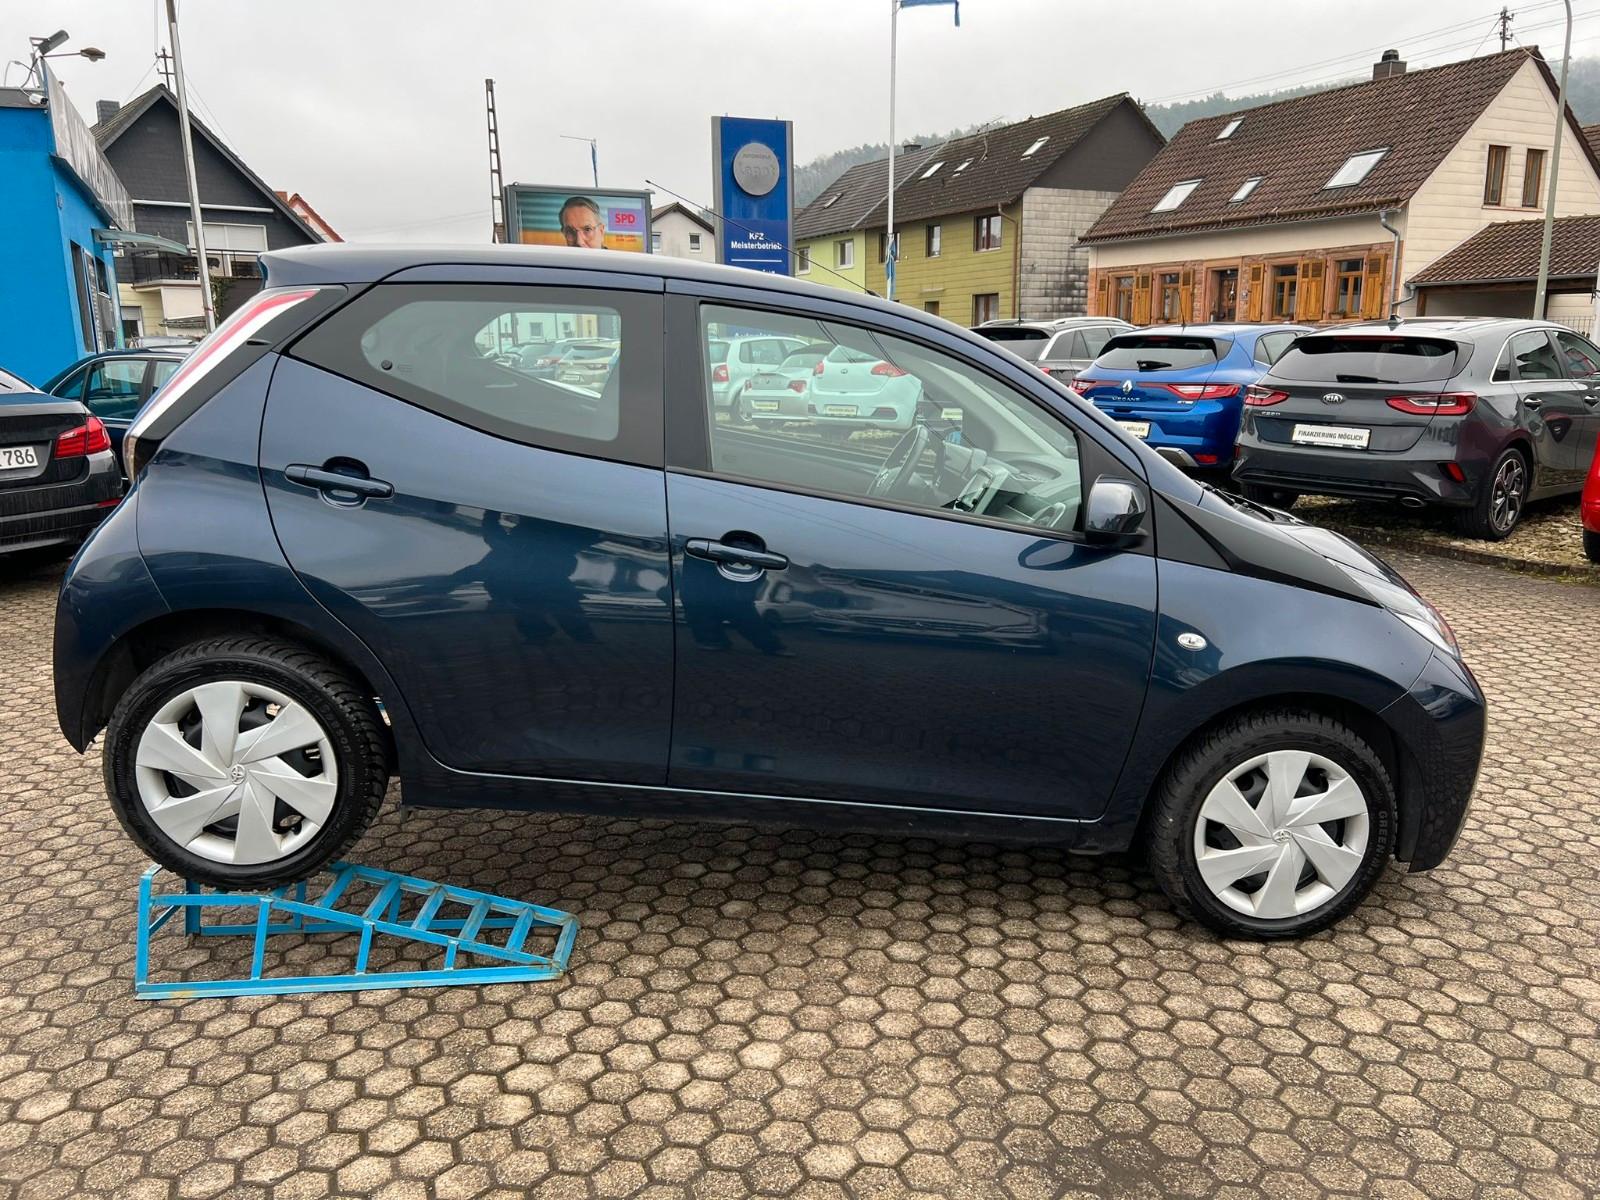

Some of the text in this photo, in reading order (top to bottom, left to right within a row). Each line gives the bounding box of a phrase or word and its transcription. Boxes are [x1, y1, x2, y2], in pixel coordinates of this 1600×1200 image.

[615, 213, 636, 224] SPD
[749, 232, 765, 240] KFZ
[731, 241, 782, 250] Meisterbetrieb
[1298, 430, 1364, 441] FINANZIERUNG MÖGLICH
[3, 449, 35, 466] 786
